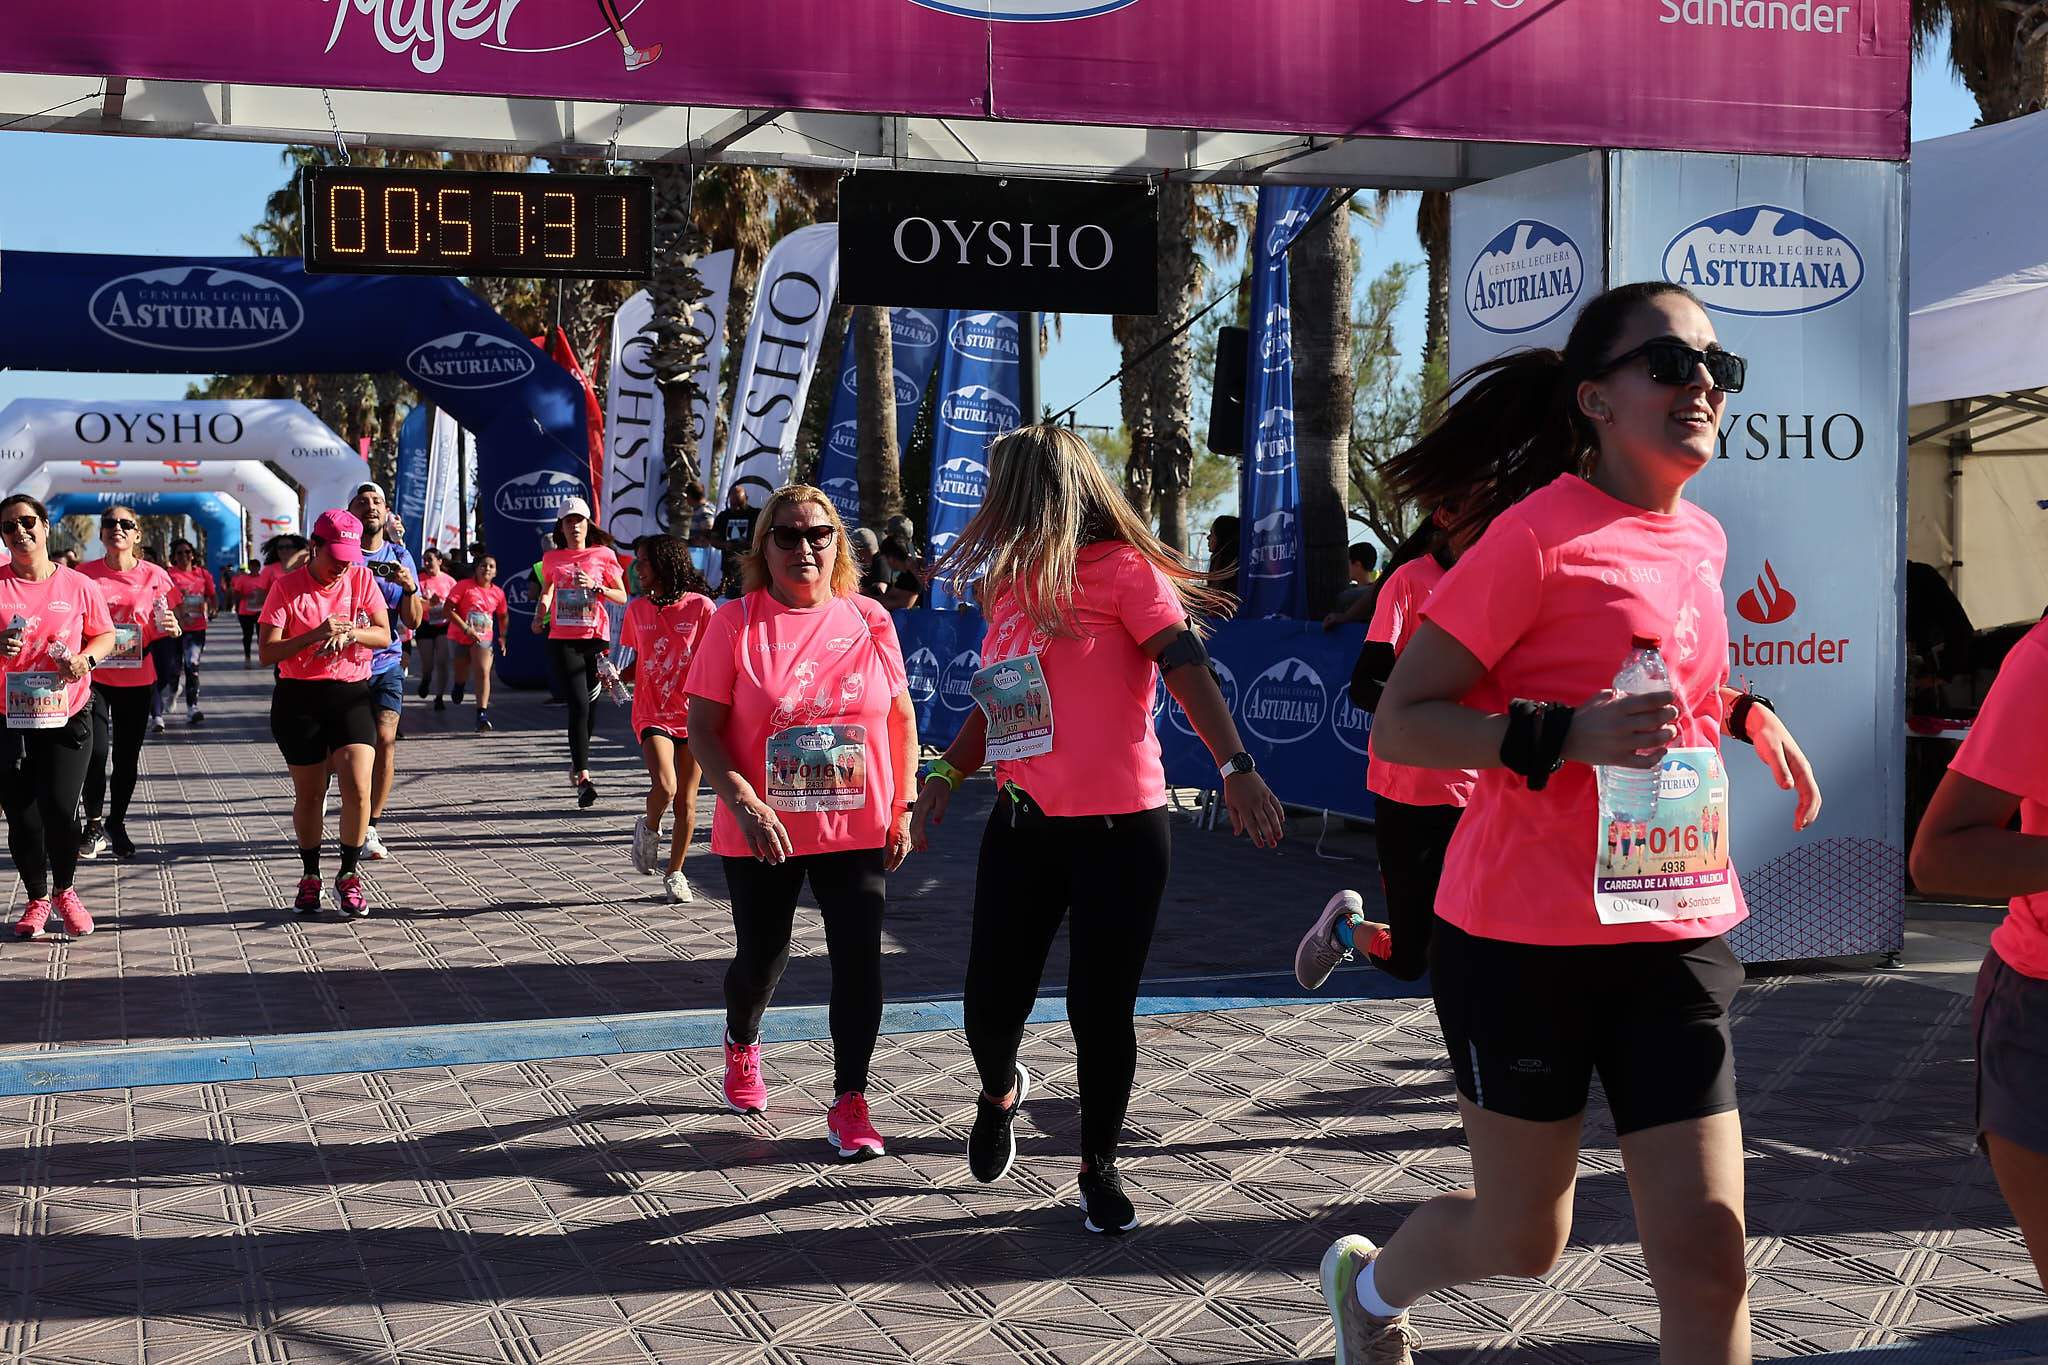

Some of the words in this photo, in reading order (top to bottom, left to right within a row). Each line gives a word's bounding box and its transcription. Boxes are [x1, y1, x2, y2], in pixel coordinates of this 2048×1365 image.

[1659, 0, 1850, 33] Santander
[330, 186, 627, 258] 00:57:31
[893, 217, 1114, 271] OYSHO
[1708, 243, 1772, 255] CENTRAL
[1778, 245, 1842, 257] LECHERA
[1489, 259, 1527, 276] CENTRAL
[1528, 251, 1570, 268] LECHERA
[1679, 244, 1848, 289] ASTURIANA
[138, 290, 209, 300] CENTRAL
[213, 291, 281, 302] LECHERA
[1473, 266, 1574, 312] ASTURIANA
[106, 290, 289, 330] ASTURIANA
[953, 326, 1019, 357] ASTURIAN
[418, 354, 527, 376] ASTURIANA
[75, 412, 244, 443] OYSHO
[944, 400, 1015, 430] ASTURIANA
[291, 446, 341, 458] OYSHO
[1717, 413, 1865, 461] YSHO
[1601, 567, 1661, 585] OYSHO
[1729, 633, 1850, 666] ntander
[1246, 687, 1319, 724] ASTURIANA
[800, 763, 836, 779] 016
[1649, 825, 1699, 854] 016
[1604, 878, 1642, 890] CARRERA
[1644, 878, 1656, 889] DE
[1657, 877, 1668, 888] LA
[1669, 875, 1694, 887] MUJER
[1661, 861, 1686, 874] 4938
[1688, 896, 1721, 908] Santander
